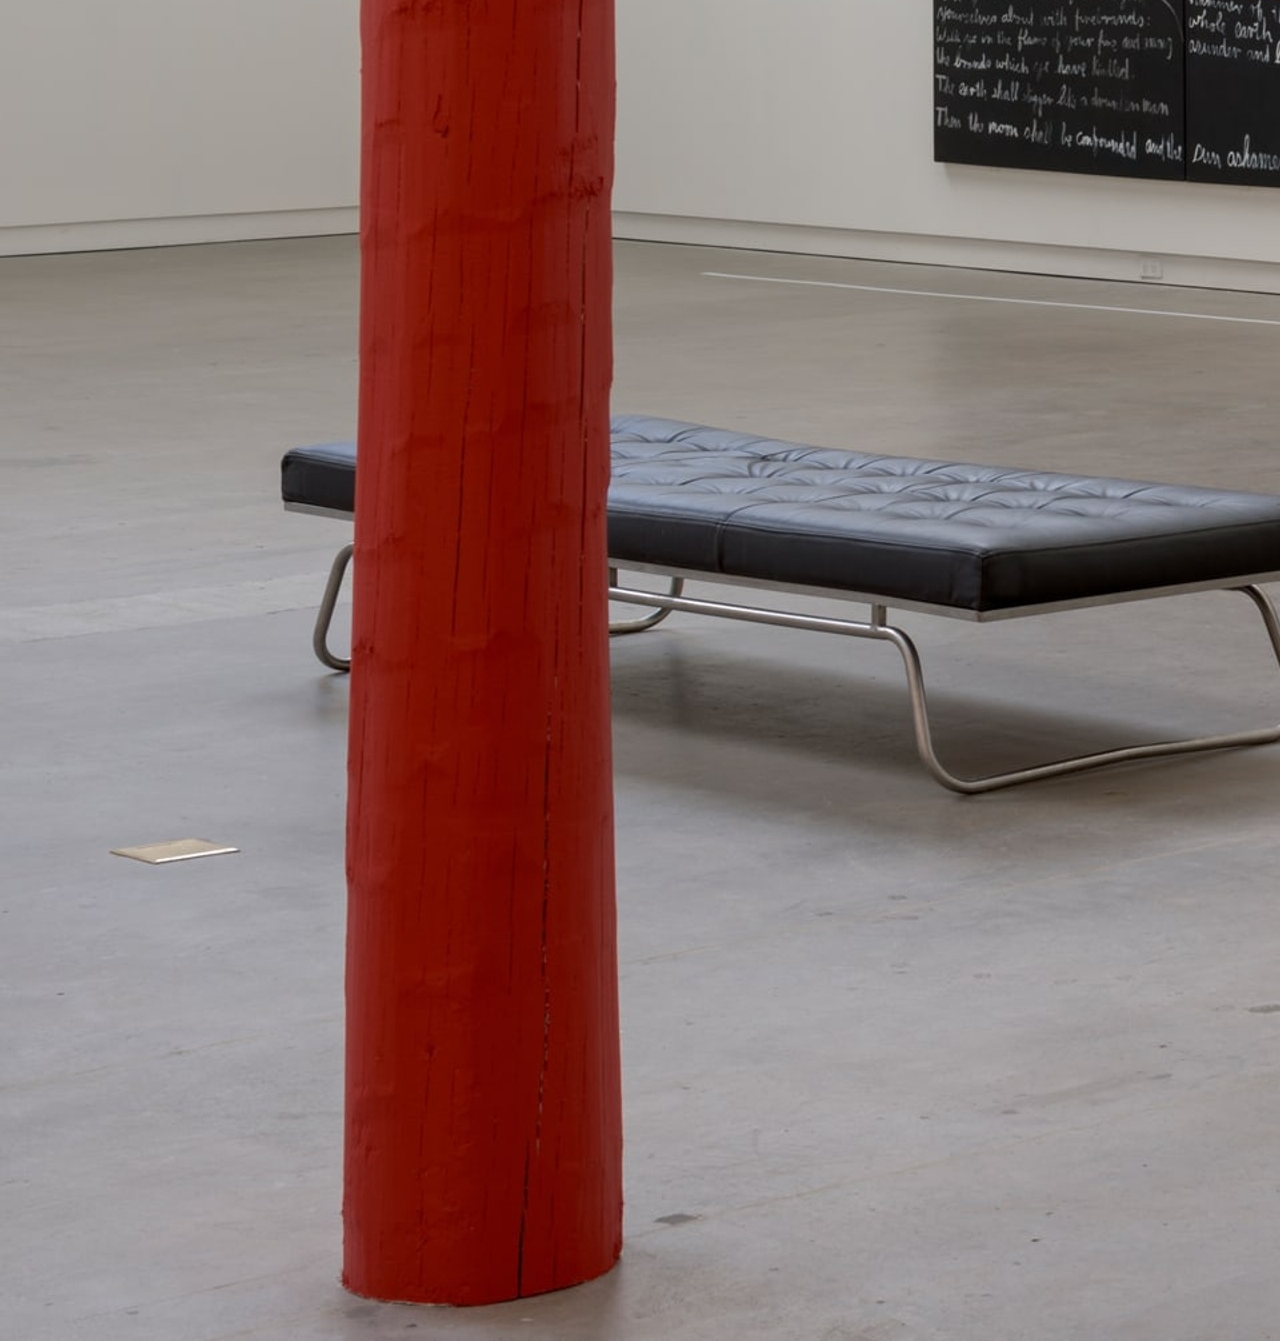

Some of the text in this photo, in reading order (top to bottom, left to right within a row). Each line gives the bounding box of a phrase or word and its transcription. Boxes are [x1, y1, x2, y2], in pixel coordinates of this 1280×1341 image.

[1001, 4, 1034, 27] about
[1188, 9, 1226, 34] whole
[1234, 18, 1273, 43] earth
[996, 51, 1029, 75] which
[1057, 53, 1086, 77] have
[1188, 38, 1242, 59] asunder
[1246, 43, 1270, 63] and
[935, 74, 955, 96] The
[958, 78, 987, 101] earth
[992, 78, 1020, 102] shall
[988, 120, 1018, 138] moon
[1192, 142, 1223, 169] sun
